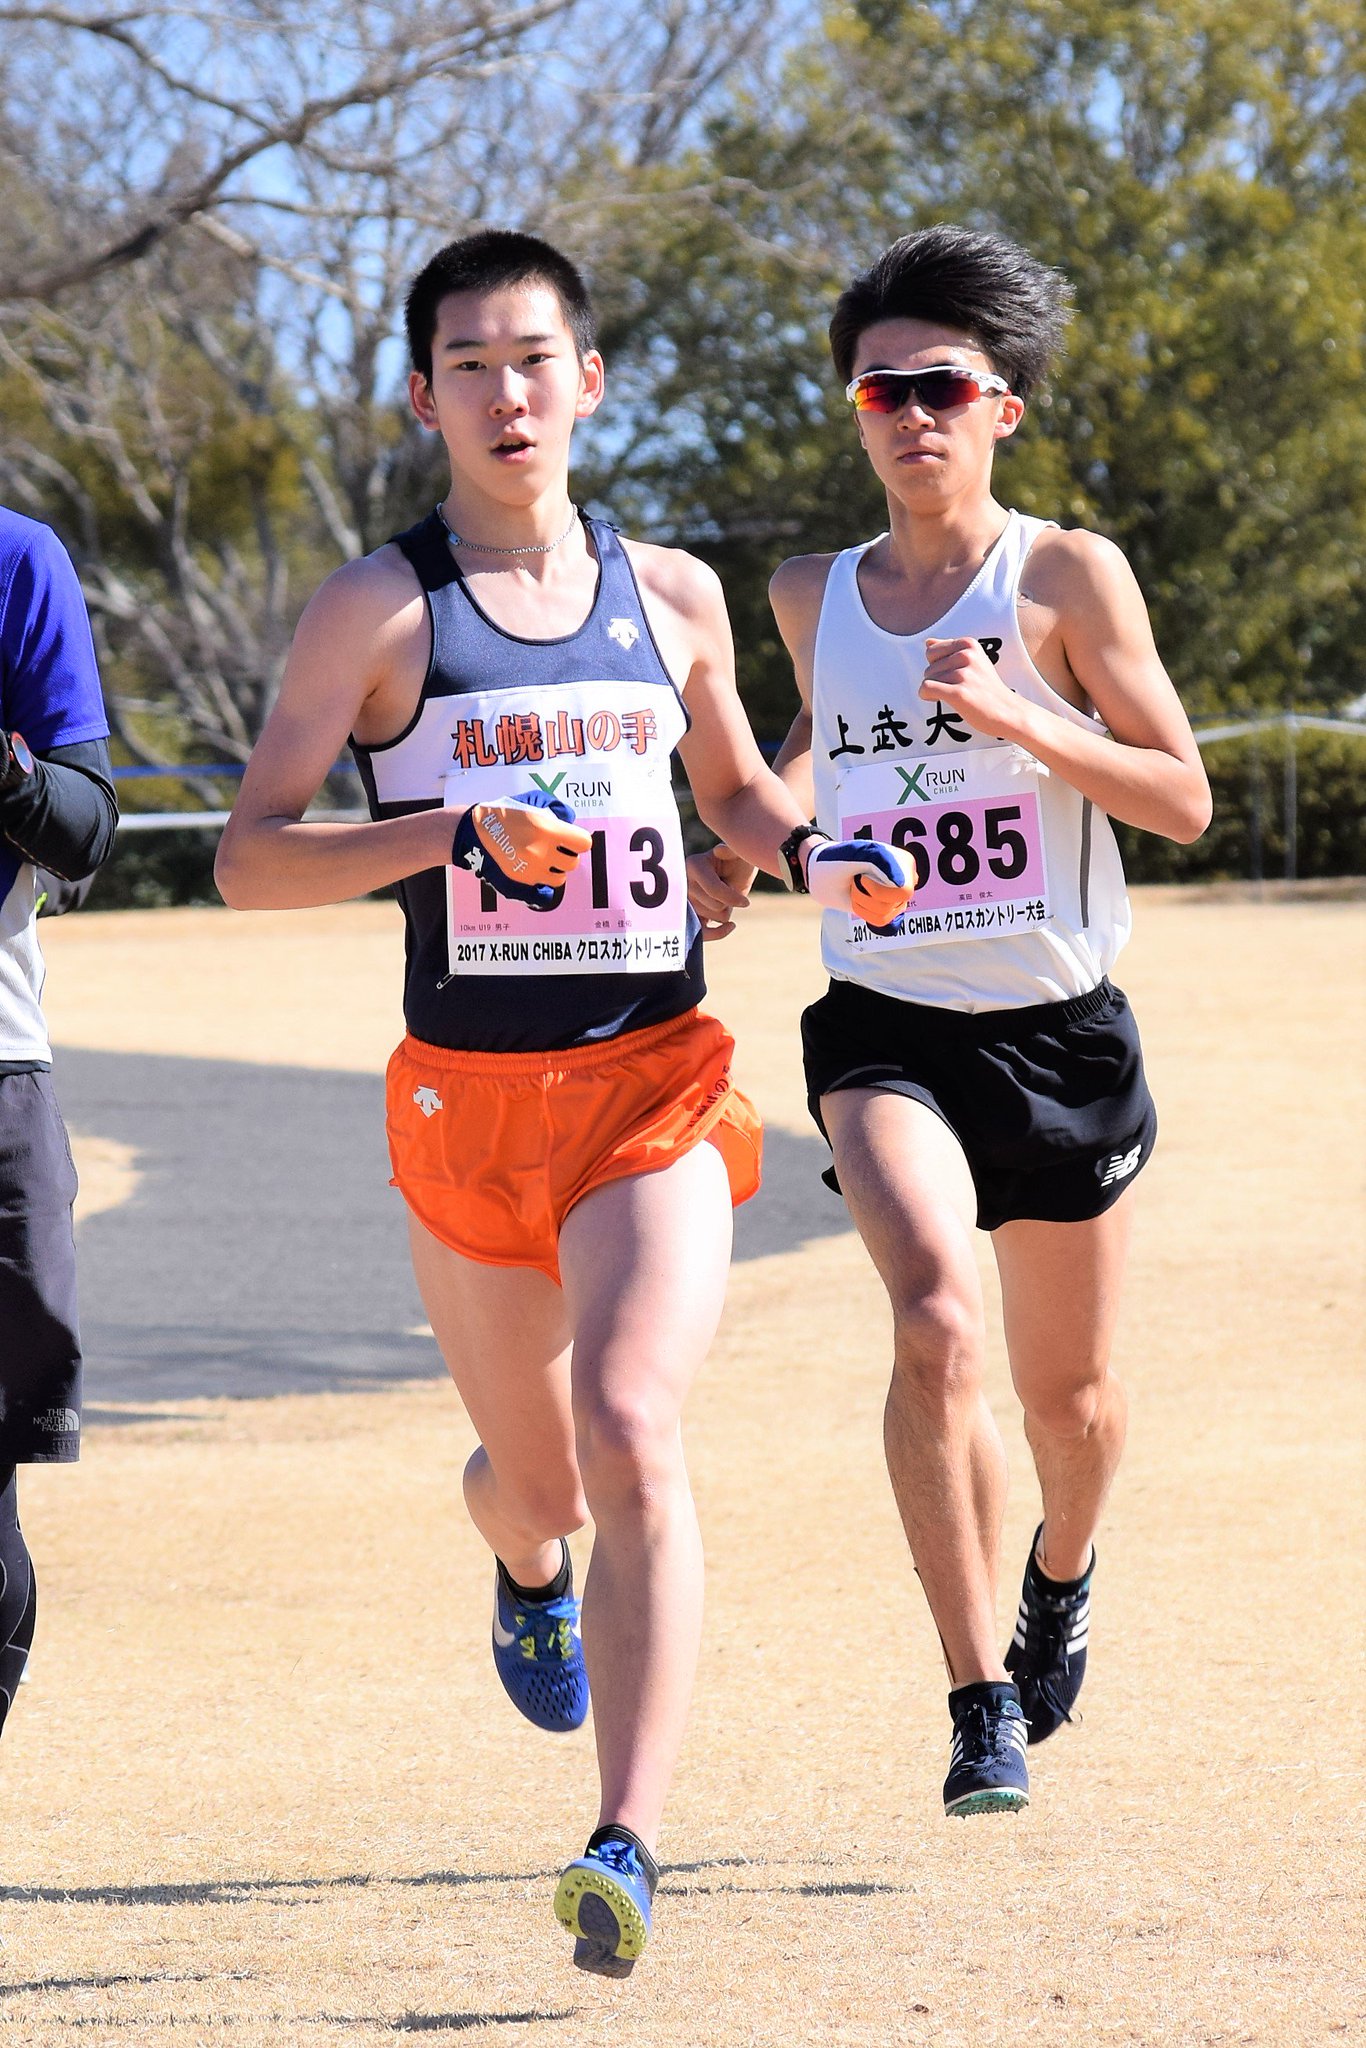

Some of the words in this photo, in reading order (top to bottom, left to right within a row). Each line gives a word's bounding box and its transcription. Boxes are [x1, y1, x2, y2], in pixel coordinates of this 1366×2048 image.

[829, 698, 1005, 760] 上武大
[451, 708, 658, 769] 札幌山の手
[933, 785, 959, 795] CHIBA
[574, 799, 604, 808] CHIBA
[853, 805, 1028, 892] 685
[908, 915, 942, 935] CHIBA
[944, 899, 1046, 933] クロスカントリー大会
[460, 924, 476, 932] 10km
[457, 943, 486, 961] 2017
[489, 942, 529, 961] X-RUN
[533, 941, 573, 961] CHIBA
[576, 935, 680, 962] クロスカントリー大会
[47, 1408, 65, 1417] THE
[33, 1416, 65, 1425] NORTH
[41, 1423, 65, 1432] FACE
